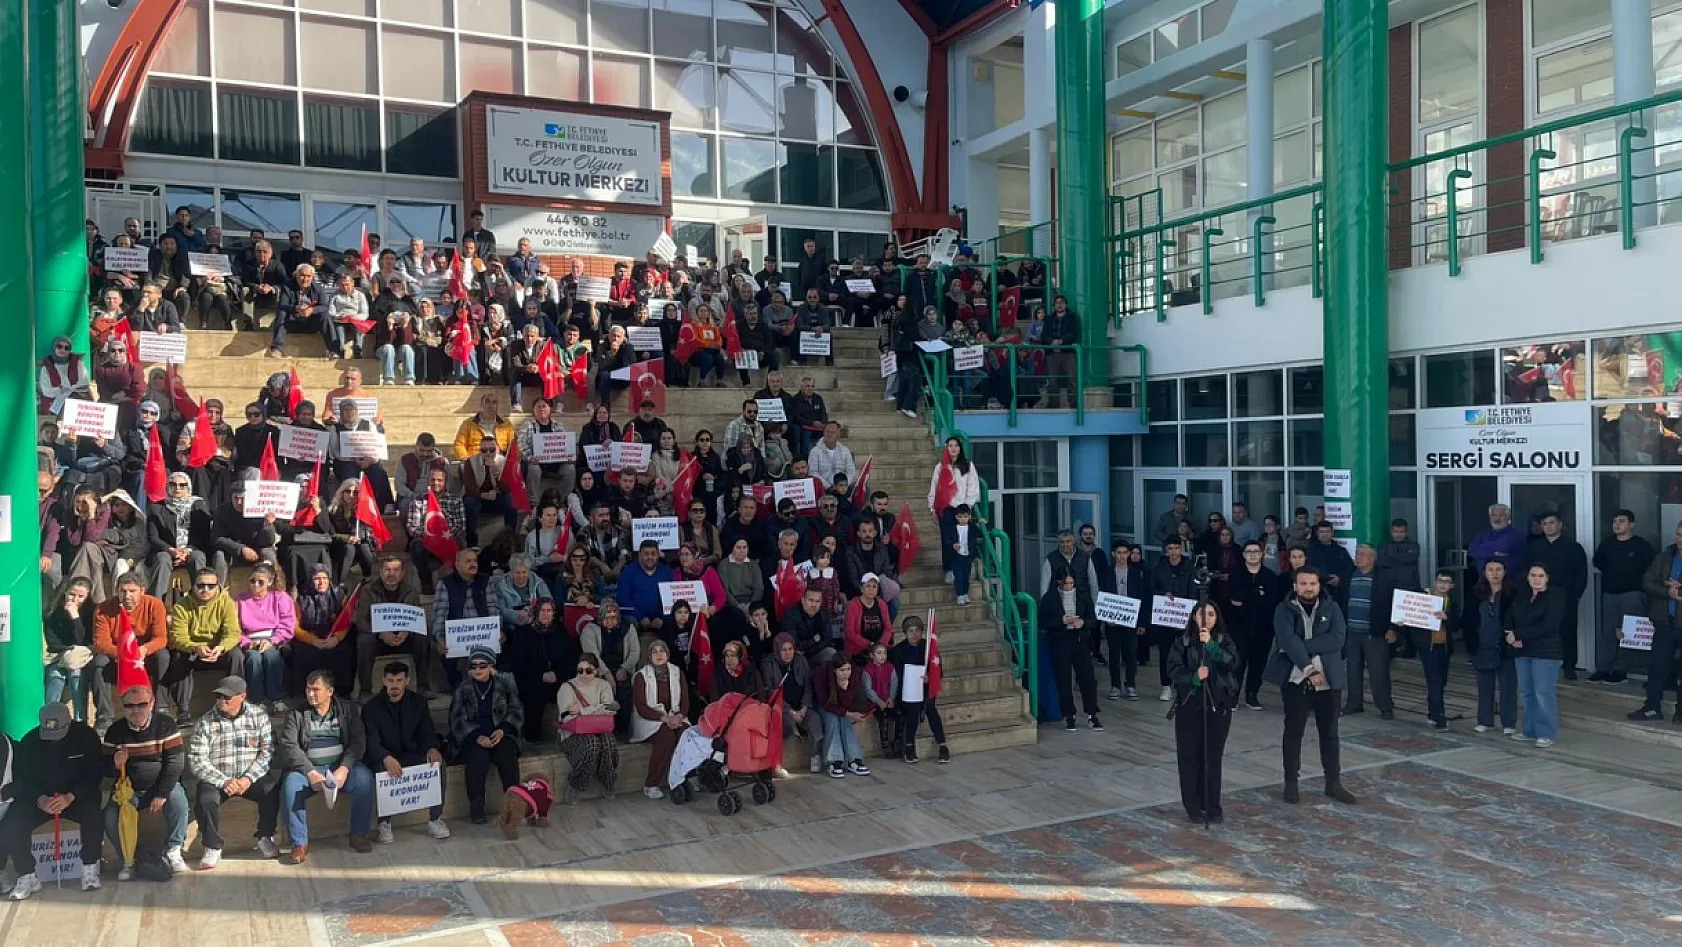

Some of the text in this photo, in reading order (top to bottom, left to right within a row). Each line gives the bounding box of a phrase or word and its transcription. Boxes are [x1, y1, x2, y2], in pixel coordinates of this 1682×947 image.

[514, 138, 638, 156] T.C. FETHİYE BELEDİYESİ
[573, 154, 624, 174] Olgun
[502, 166, 650, 193] KÜLTÜR MERKEZİ
[546, 214, 608, 227] 444 90 82
[523, 226, 631, 240] www.fethiye.bel.tr
[1487, 406, 1532, 417] T.C. FETHİYE
[1486, 416, 1532, 425] BELEDİYESİ
[1469, 436, 1528, 445] KÜLTÜR MERKEZİ
[1426, 447, 1580, 468] SERGİ SALONU
[634, 522, 656, 530] TURİZM
[382, 614, 417, 622] EKONOMİ
[402, 608, 424, 616] VARSA
[1098, 609, 1134, 623] TURİZM!
[448, 622, 498, 633] TURİZM VARSA
[456, 632, 491, 642] EKONOMİ
[380, 770, 438, 788] TURİZM VARSA
[390, 782, 429, 798] EKONOMİ
[401, 794, 420, 806] VAR!
